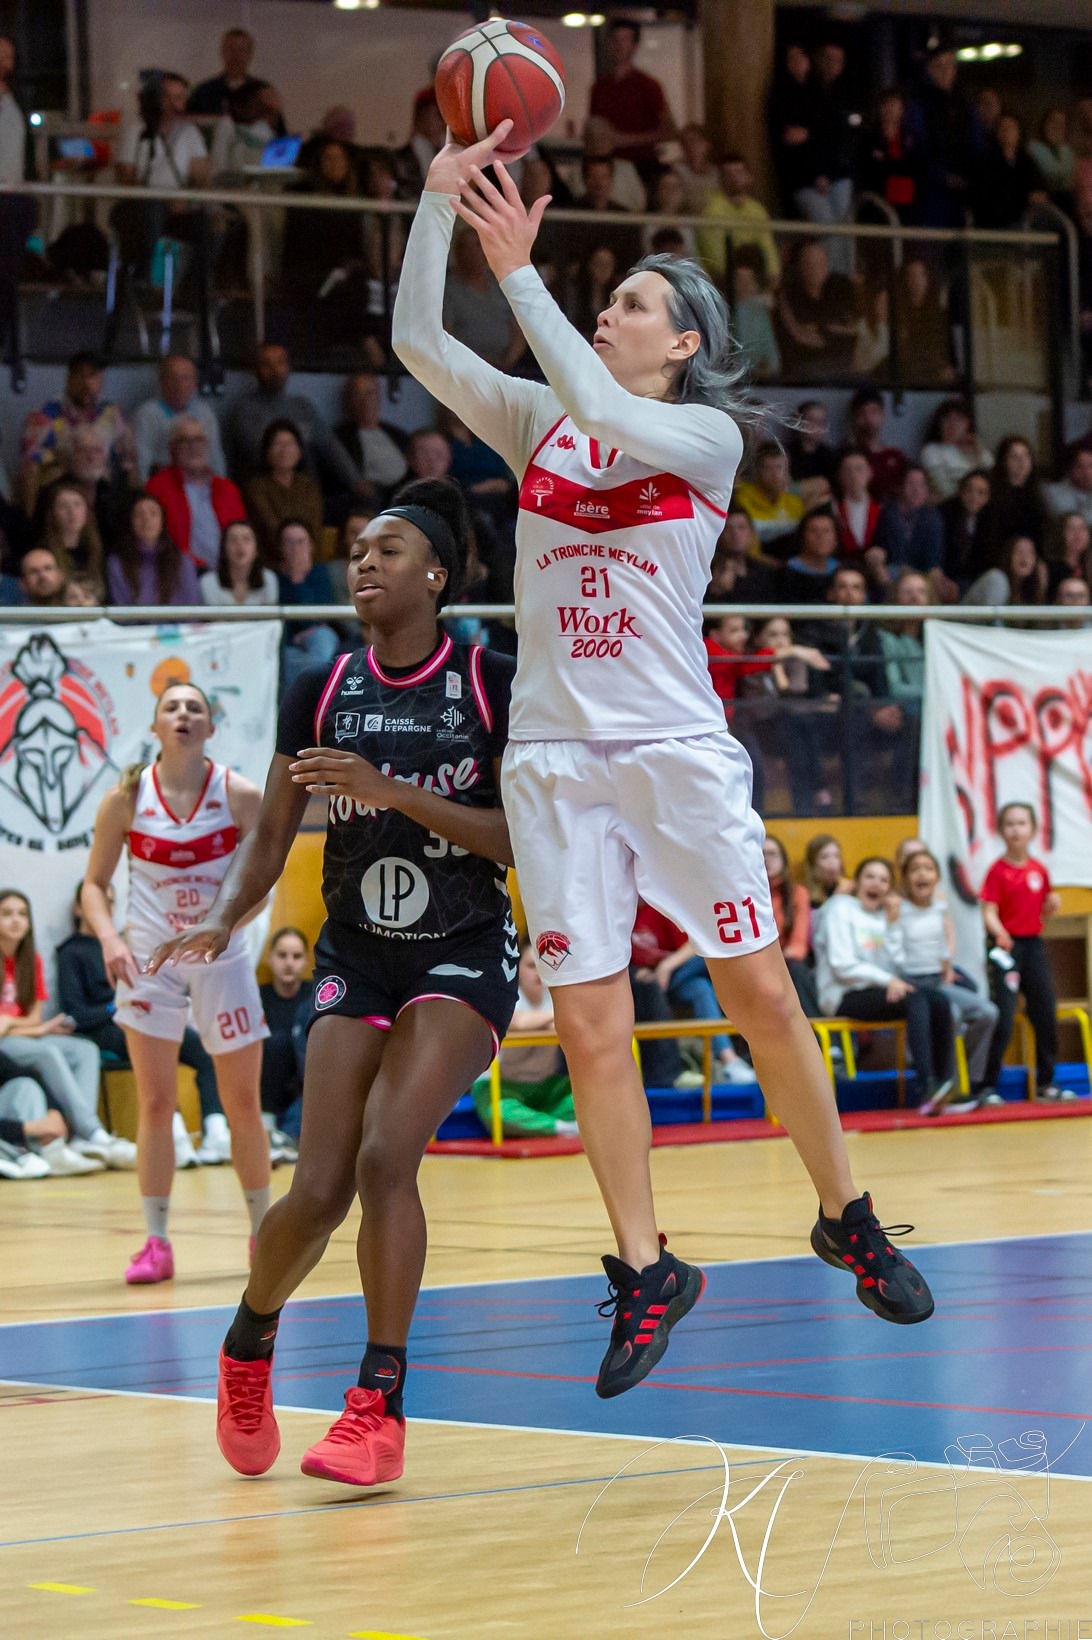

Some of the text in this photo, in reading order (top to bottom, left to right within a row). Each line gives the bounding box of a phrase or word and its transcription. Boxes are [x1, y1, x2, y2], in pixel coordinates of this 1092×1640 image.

[575, 500, 609, 514] isère
[536, 544, 658, 577] LA TRONCHE MEYLAN
[580, 566, 610, 598] 21
[557, 606, 643, 639] Work
[570, 639, 623, 659] 2000
[436, 732, 469, 740] Occitanie
[176, 888, 200, 908] 20
[713, 896, 760, 945] 21
[217, 1006, 251, 1041] 20
